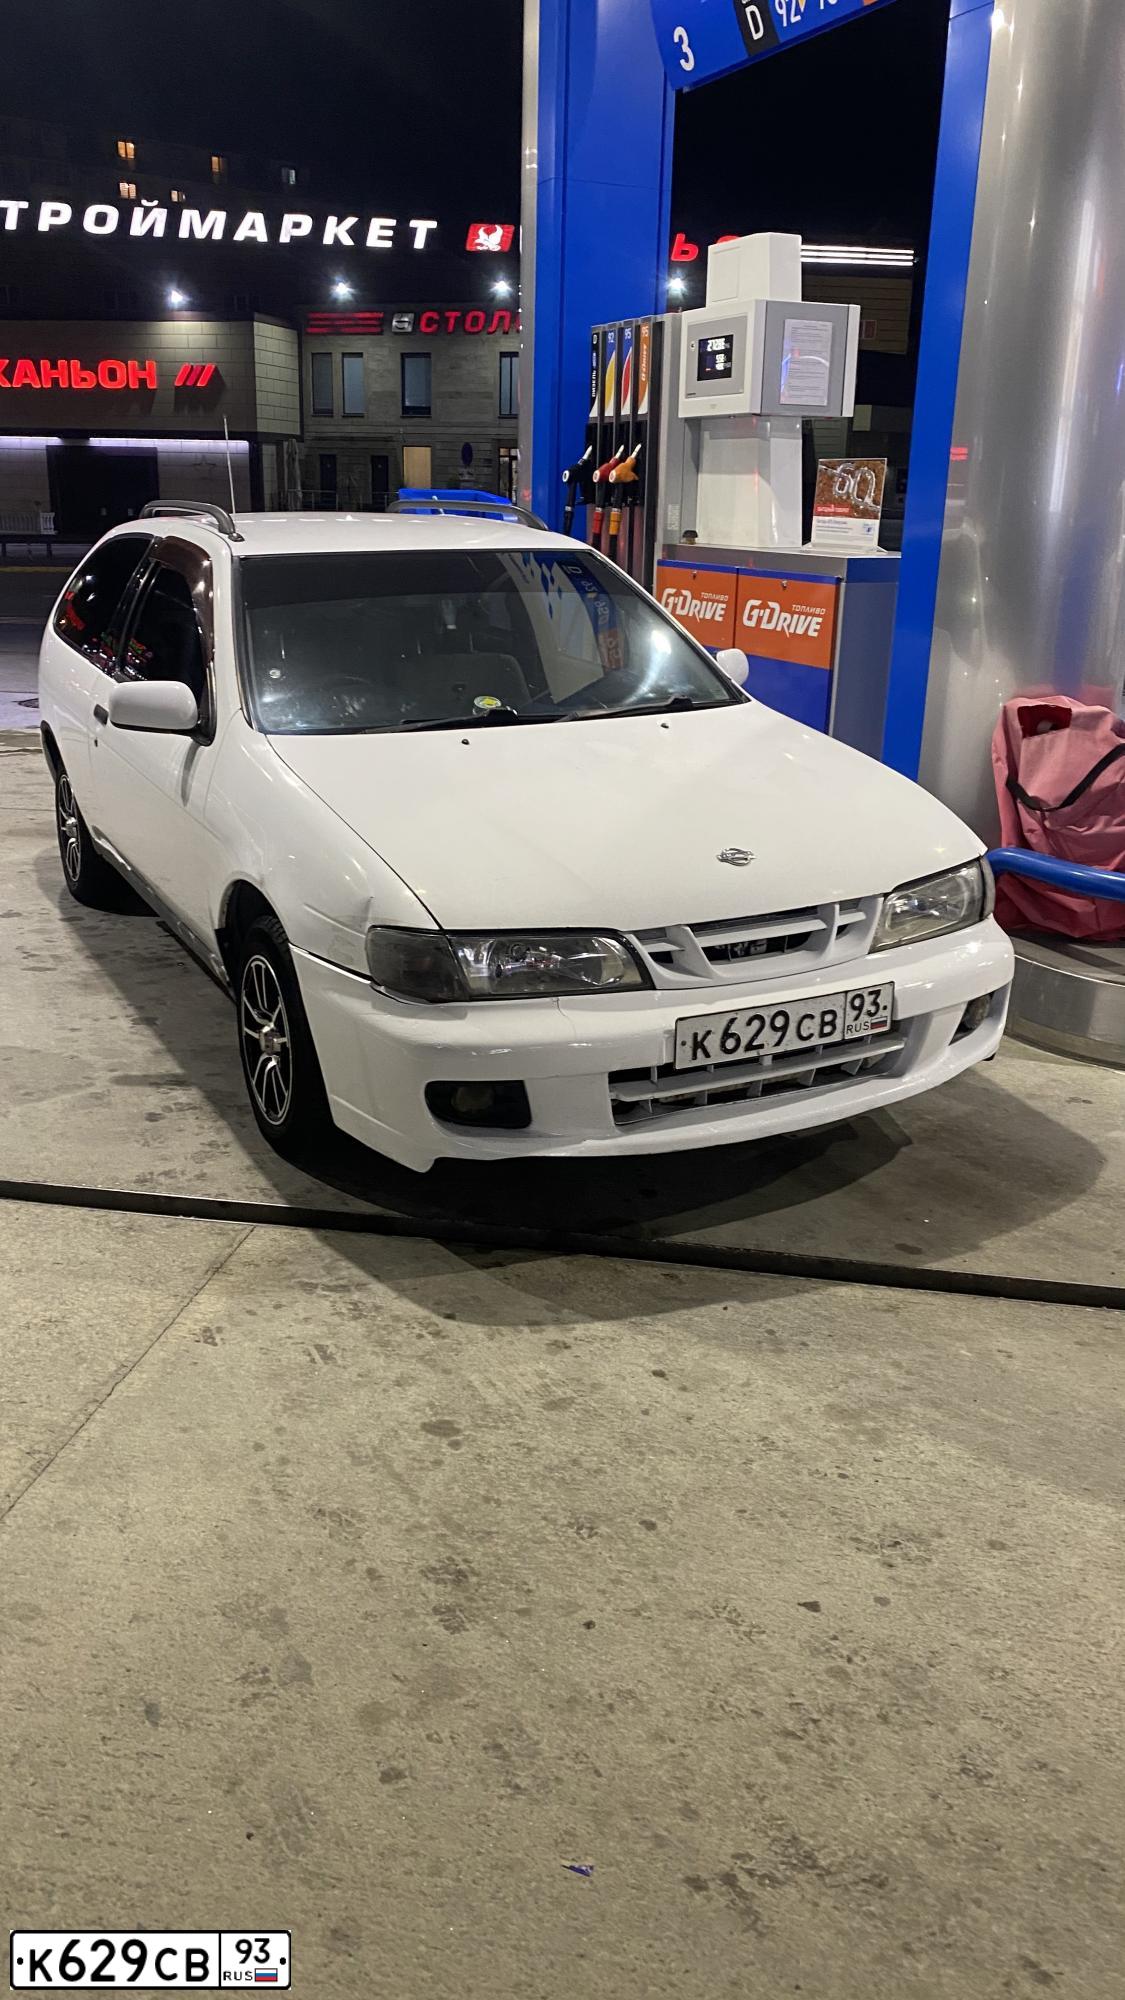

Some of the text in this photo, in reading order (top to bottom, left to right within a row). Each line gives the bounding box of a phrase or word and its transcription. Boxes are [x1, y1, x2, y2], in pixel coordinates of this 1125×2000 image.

[745, 4, 764, 41] D
[774, 0, 802, 28] 92
[673, 26, 695, 72] 3
[0, 199, 438, 250] ТРОЙМАРКЕТ
[419, 309, 520, 334] СТОЛ
[701, 591, 729, 602] ТОПЛИВО
[791, 604, 826, 616] ТОПЛИВО
[691, 988, 882, 1061] К629СВ 93
[846, 1021, 870, 1034] RUS
